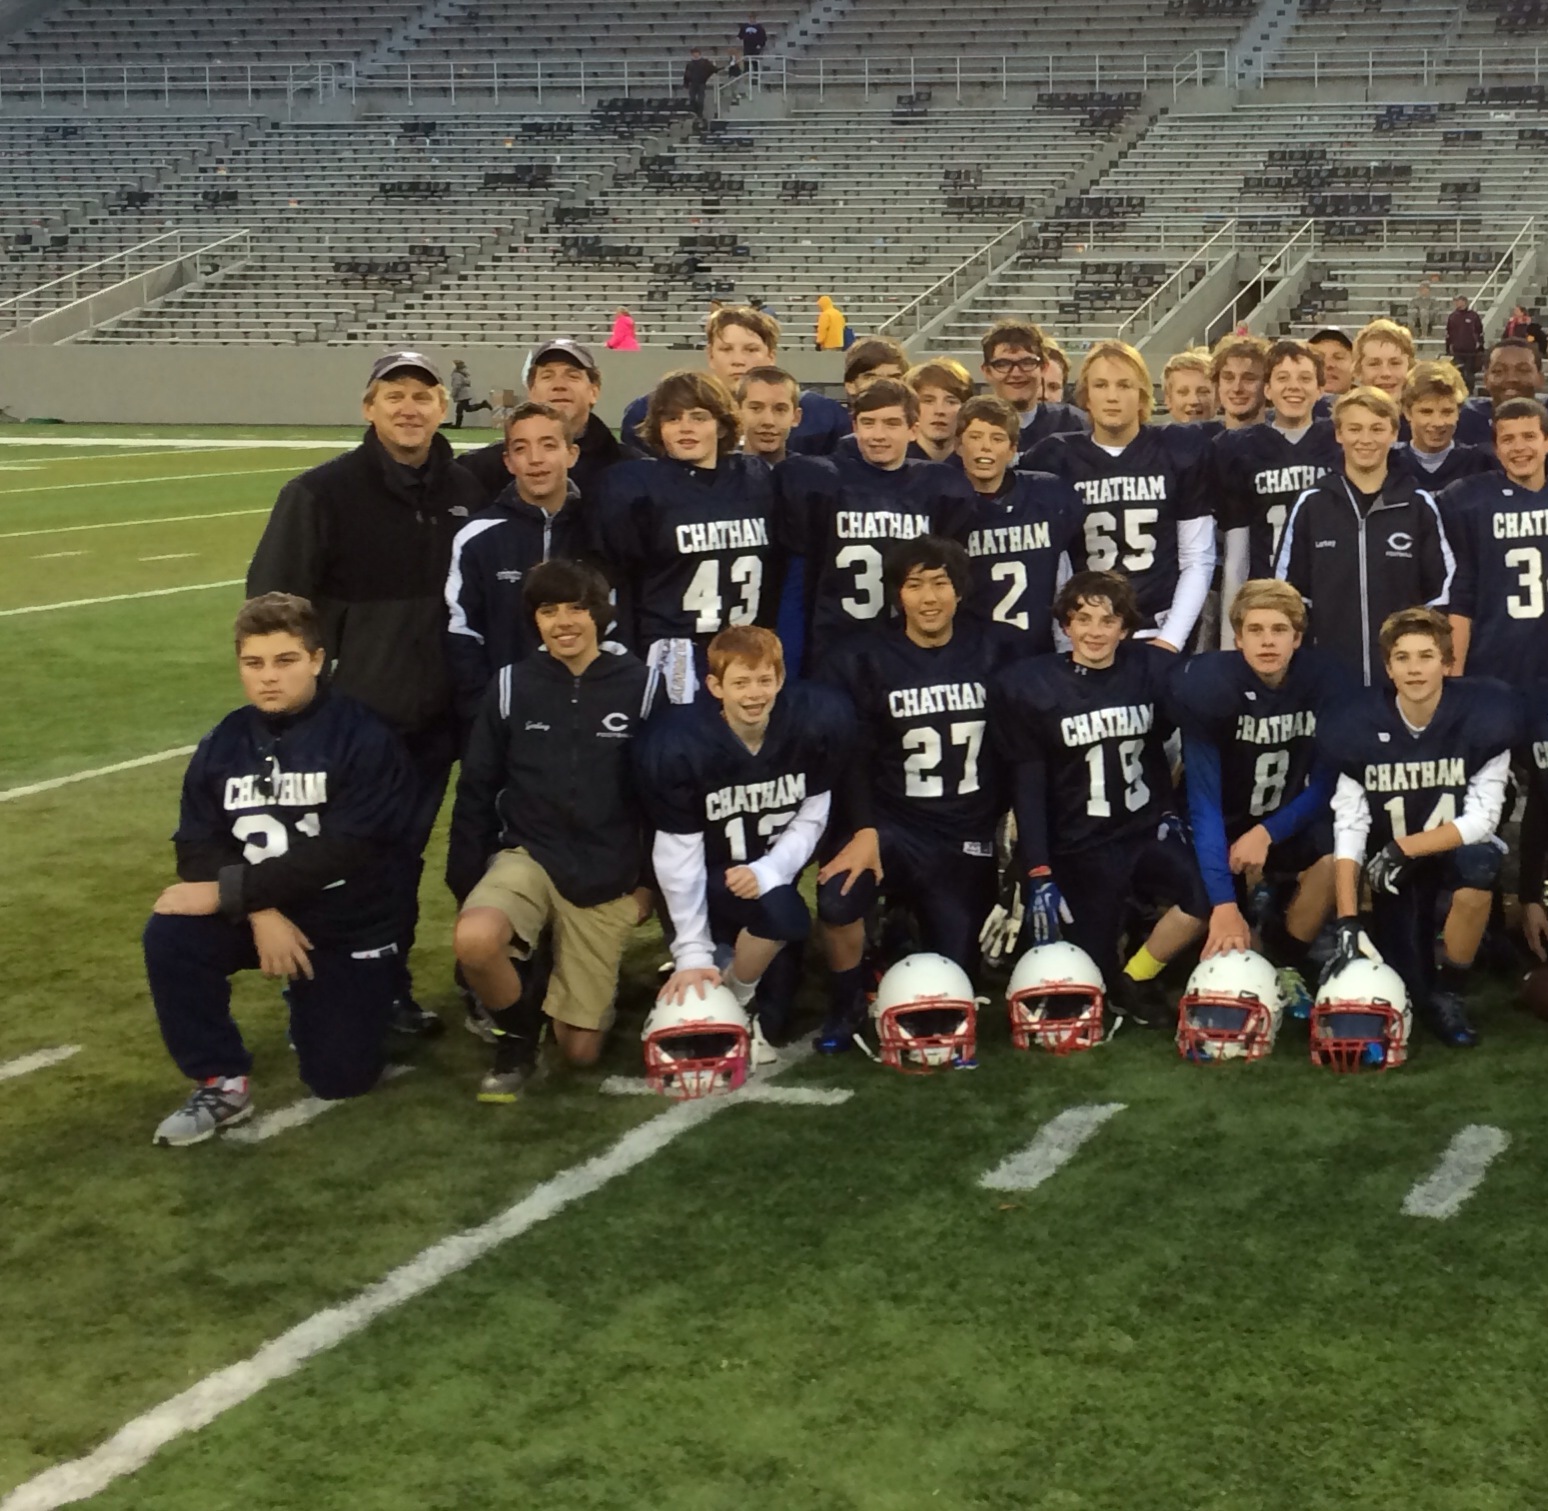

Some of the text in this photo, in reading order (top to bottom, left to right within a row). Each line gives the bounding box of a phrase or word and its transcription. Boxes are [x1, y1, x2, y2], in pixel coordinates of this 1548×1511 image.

[676, 517, 769, 554] CHATHAM
[836, 511, 931, 540] CHATHAM
[963, 521, 1052, 558] HATHAM
[1083, 508, 1159, 572] 65
[1387, 532, 1414, 551] C
[683, 555, 763, 634] 43
[991, 560, 1030, 631] 2
[601, 712, 629, 732] C
[901, 720, 987, 798] 27
[1364, 757, 1466, 792] CHATHAM
[705, 772, 806, 822] CHATHAM
[1249, 749, 1290, 817] 8
